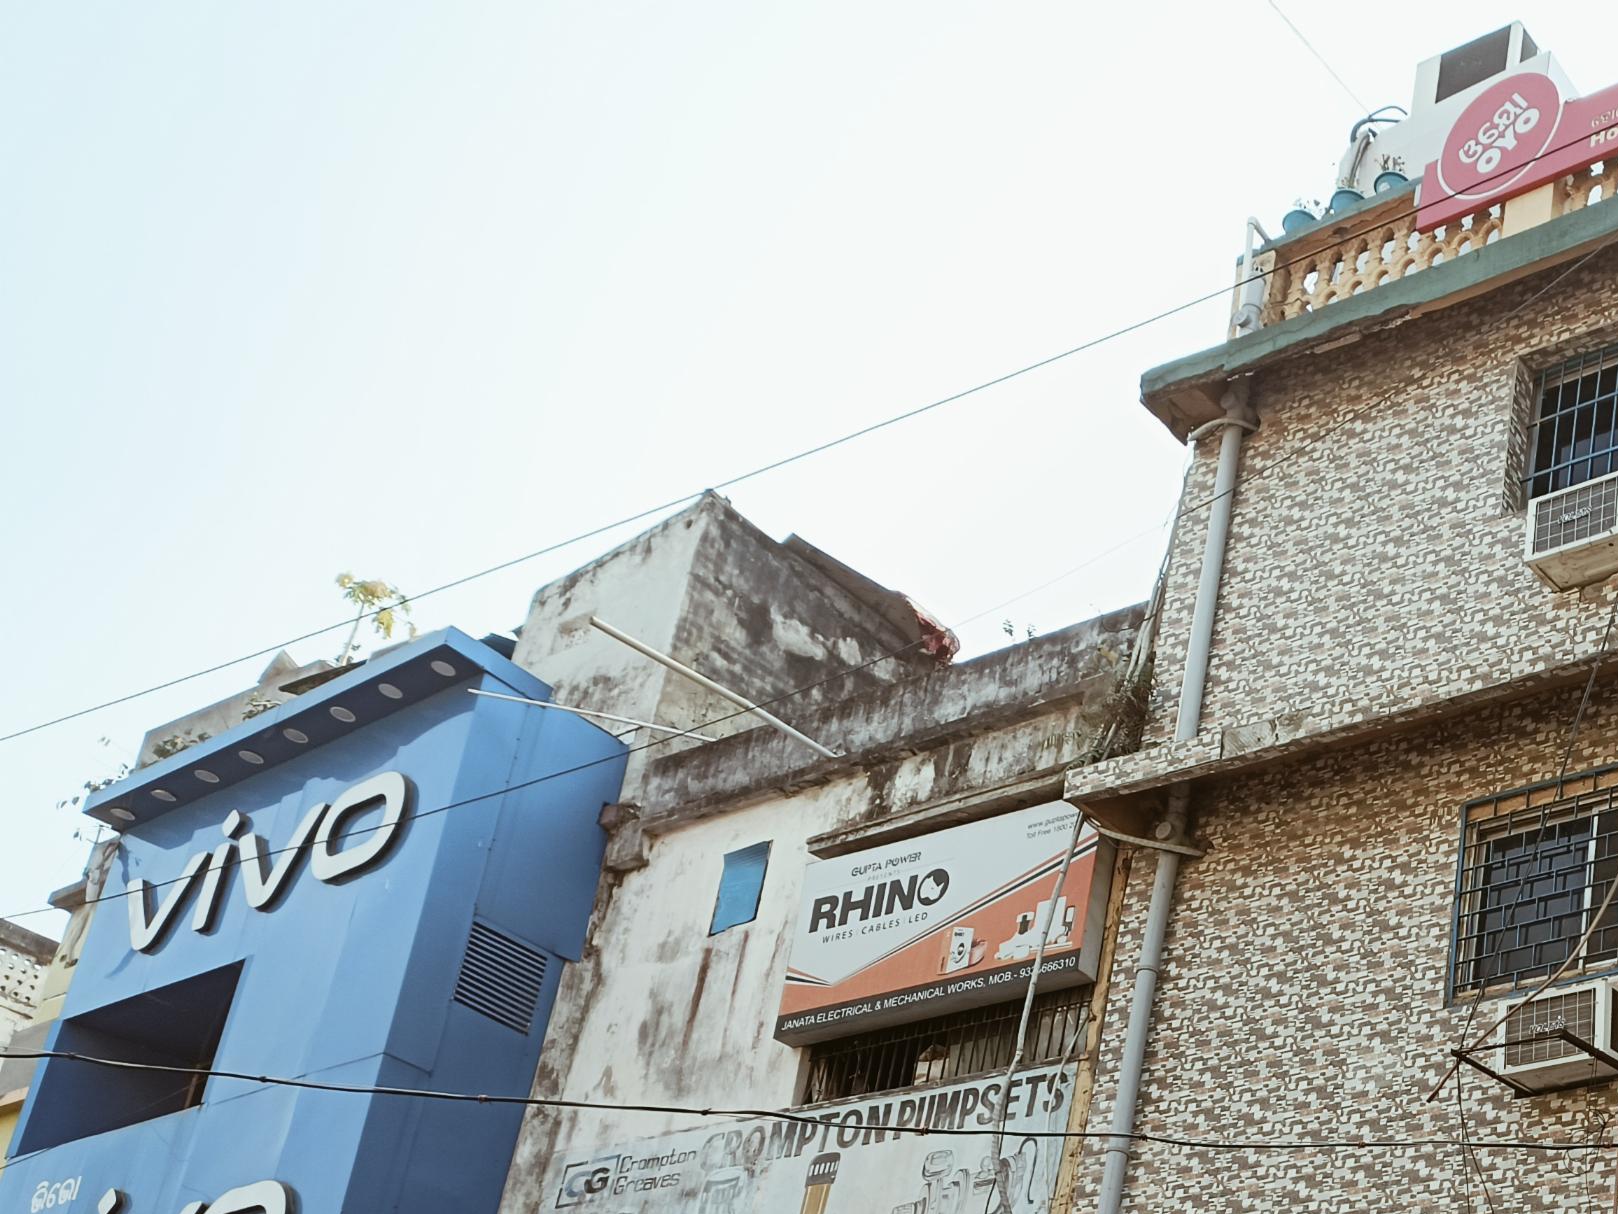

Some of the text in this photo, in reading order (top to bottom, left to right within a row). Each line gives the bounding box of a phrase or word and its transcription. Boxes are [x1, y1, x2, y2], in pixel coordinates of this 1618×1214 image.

[1477, 108, 1540, 173] OYO
[127, 771, 406, 951] vivo
[851, 852, 922, 877] GUPTA POWER
[808, 868, 950, 933] RHINO
[822, 912, 928, 943] WIRES CABLES LED
[781, 1015, 815, 1031] JANATA
[817, 1003, 873, 1023] ELECTRICAL
[875, 1001, 882, 1010] &
[884, 986, 945, 1008] MECHANICAL
[1019, 956, 1076, 978] 933666310
[701, 1072, 1070, 1169] CROMPTON PUMPSETS
[613, 1172, 681, 1195] Greaves
[619, 1148, 697, 1174] Crompton
